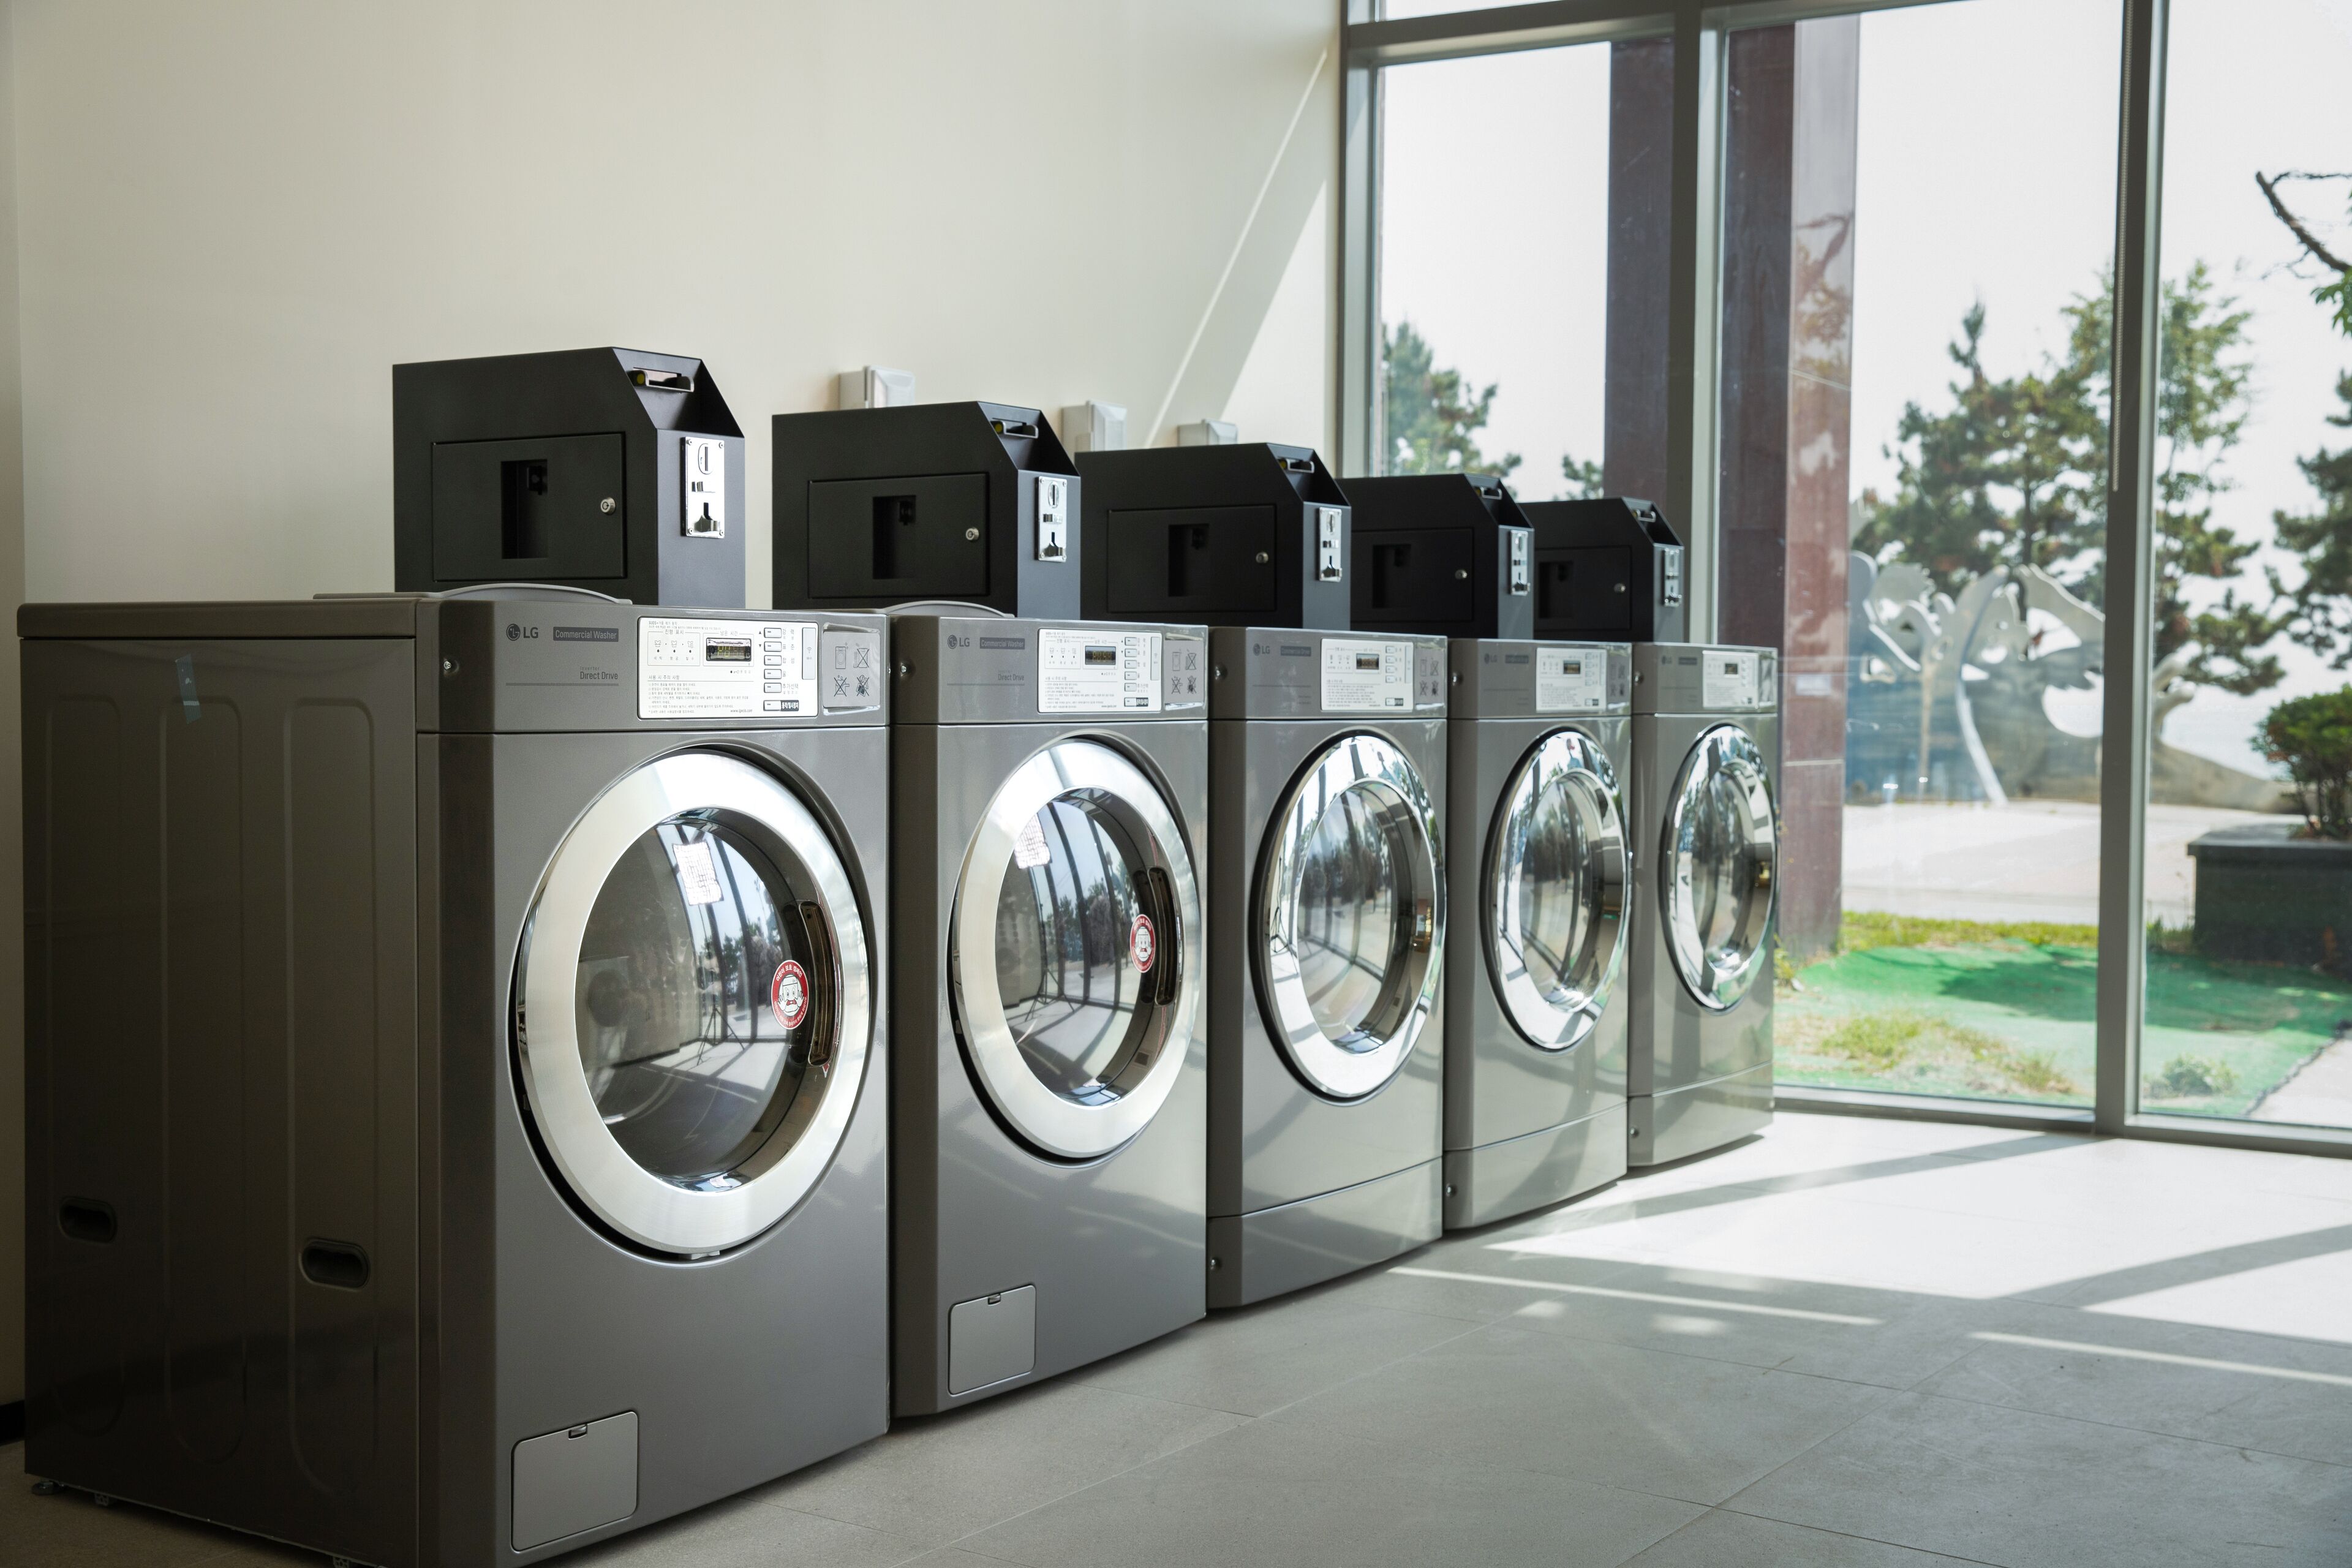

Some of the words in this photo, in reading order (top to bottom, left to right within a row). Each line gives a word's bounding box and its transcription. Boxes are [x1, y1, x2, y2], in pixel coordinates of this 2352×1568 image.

[523, 627, 539, 639] LG
[556, 630, 592, 639] Commercial
[593, 631, 617, 639] Washer
[959, 637, 970, 647] LG
[1262, 646, 1270, 654] LG
[580, 671, 600, 680] Direct
[601, 671, 619, 680] Drive
[776, 967, 785, 981] 어린이
